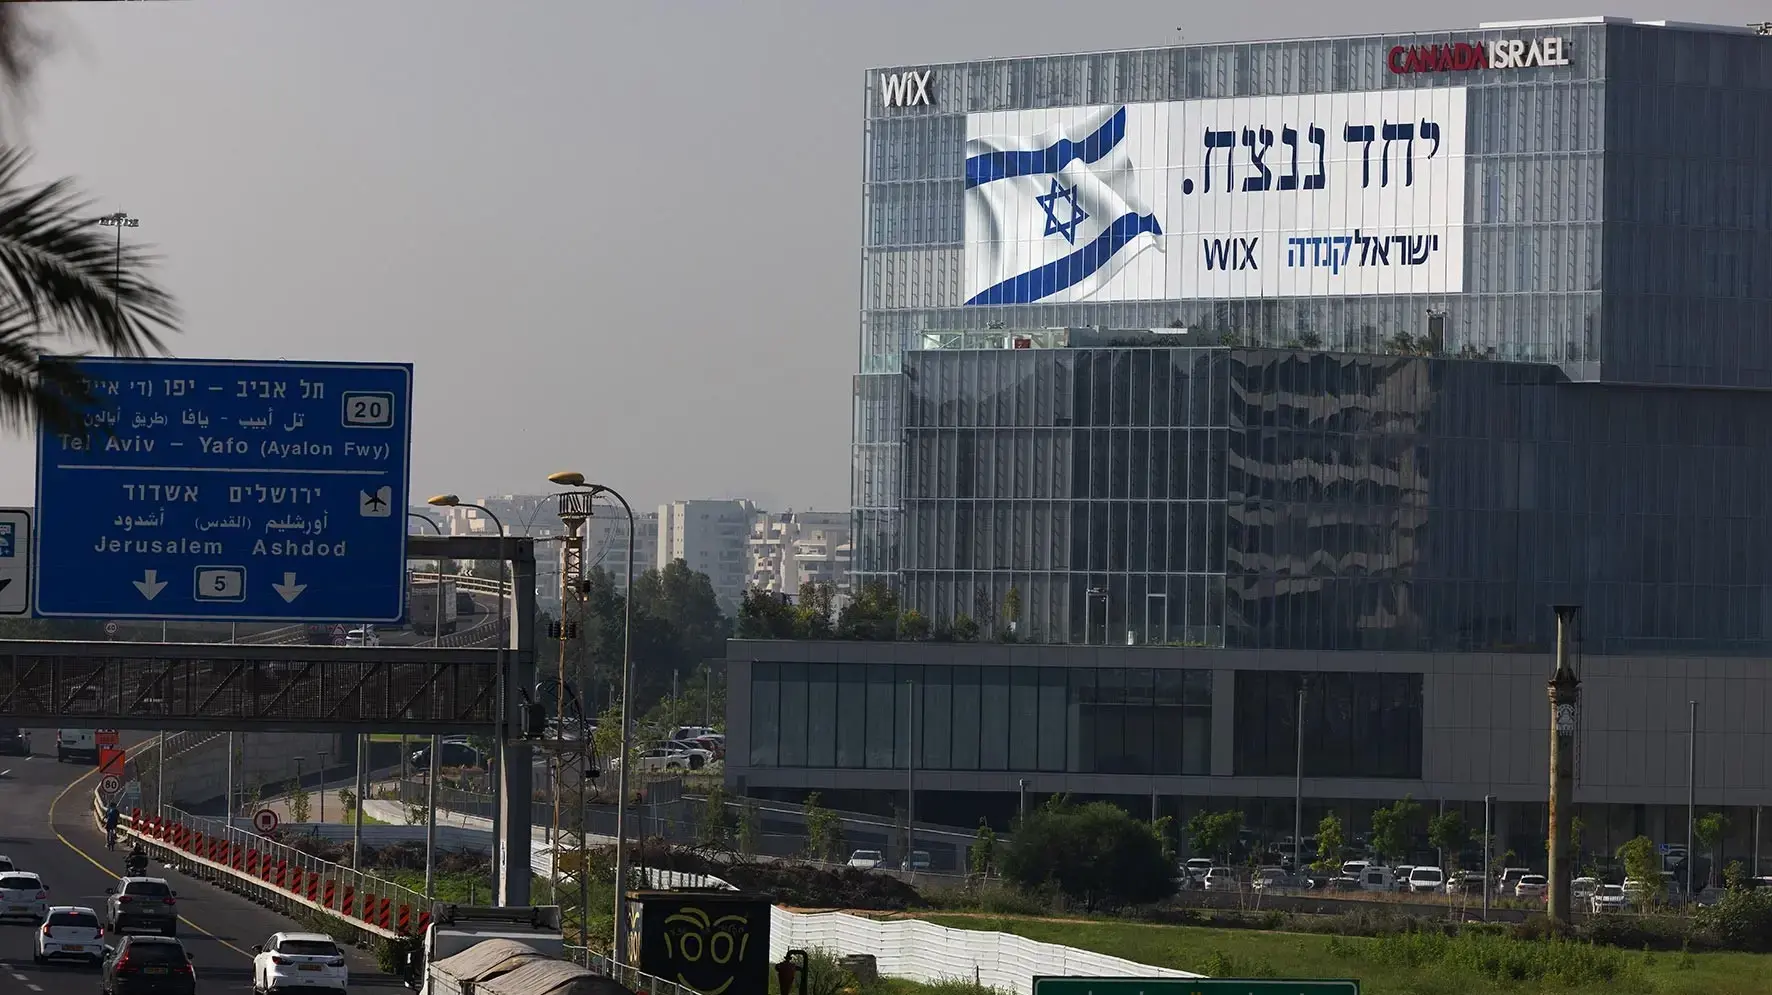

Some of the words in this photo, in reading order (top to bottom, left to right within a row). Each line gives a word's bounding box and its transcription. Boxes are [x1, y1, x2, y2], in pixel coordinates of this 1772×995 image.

[1182, 122, 1326, 195] ננצח.
[1344, 118, 1440, 189] יחד
[1204, 237, 1258, 271] WIX
[164, 379, 195, 396] יפו
[237, 380, 286, 398] אביב
[300, 379, 324, 399] תל
[83, 406, 120, 428] أيالون
[182, 408, 209, 428] يافا
[239, 407, 274, 430] أبيب
[354, 402, 381, 418] 20
[284, 412, 305, 431] تل
[58, 433, 90, 451] Tel
[105, 435, 154, 452] Aviv
[199, 437, 249, 455] Yafo
[261, 440, 333, 458] (Ayalon
[344, 442, 390, 460] Fwy)
[123, 484, 198, 502] אשדוד
[229, 484, 321, 504] ירושלים
[114, 507, 164, 531] أشدود
[195, 515, 251, 531] (القدس)
[265, 510, 328, 534] أورشليم
[94, 536, 223, 554] Jerusalem
[252, 539, 346, 557] Ashdod
[213, 576, 226, 592] 5
[105, 780, 117, 789] 80
